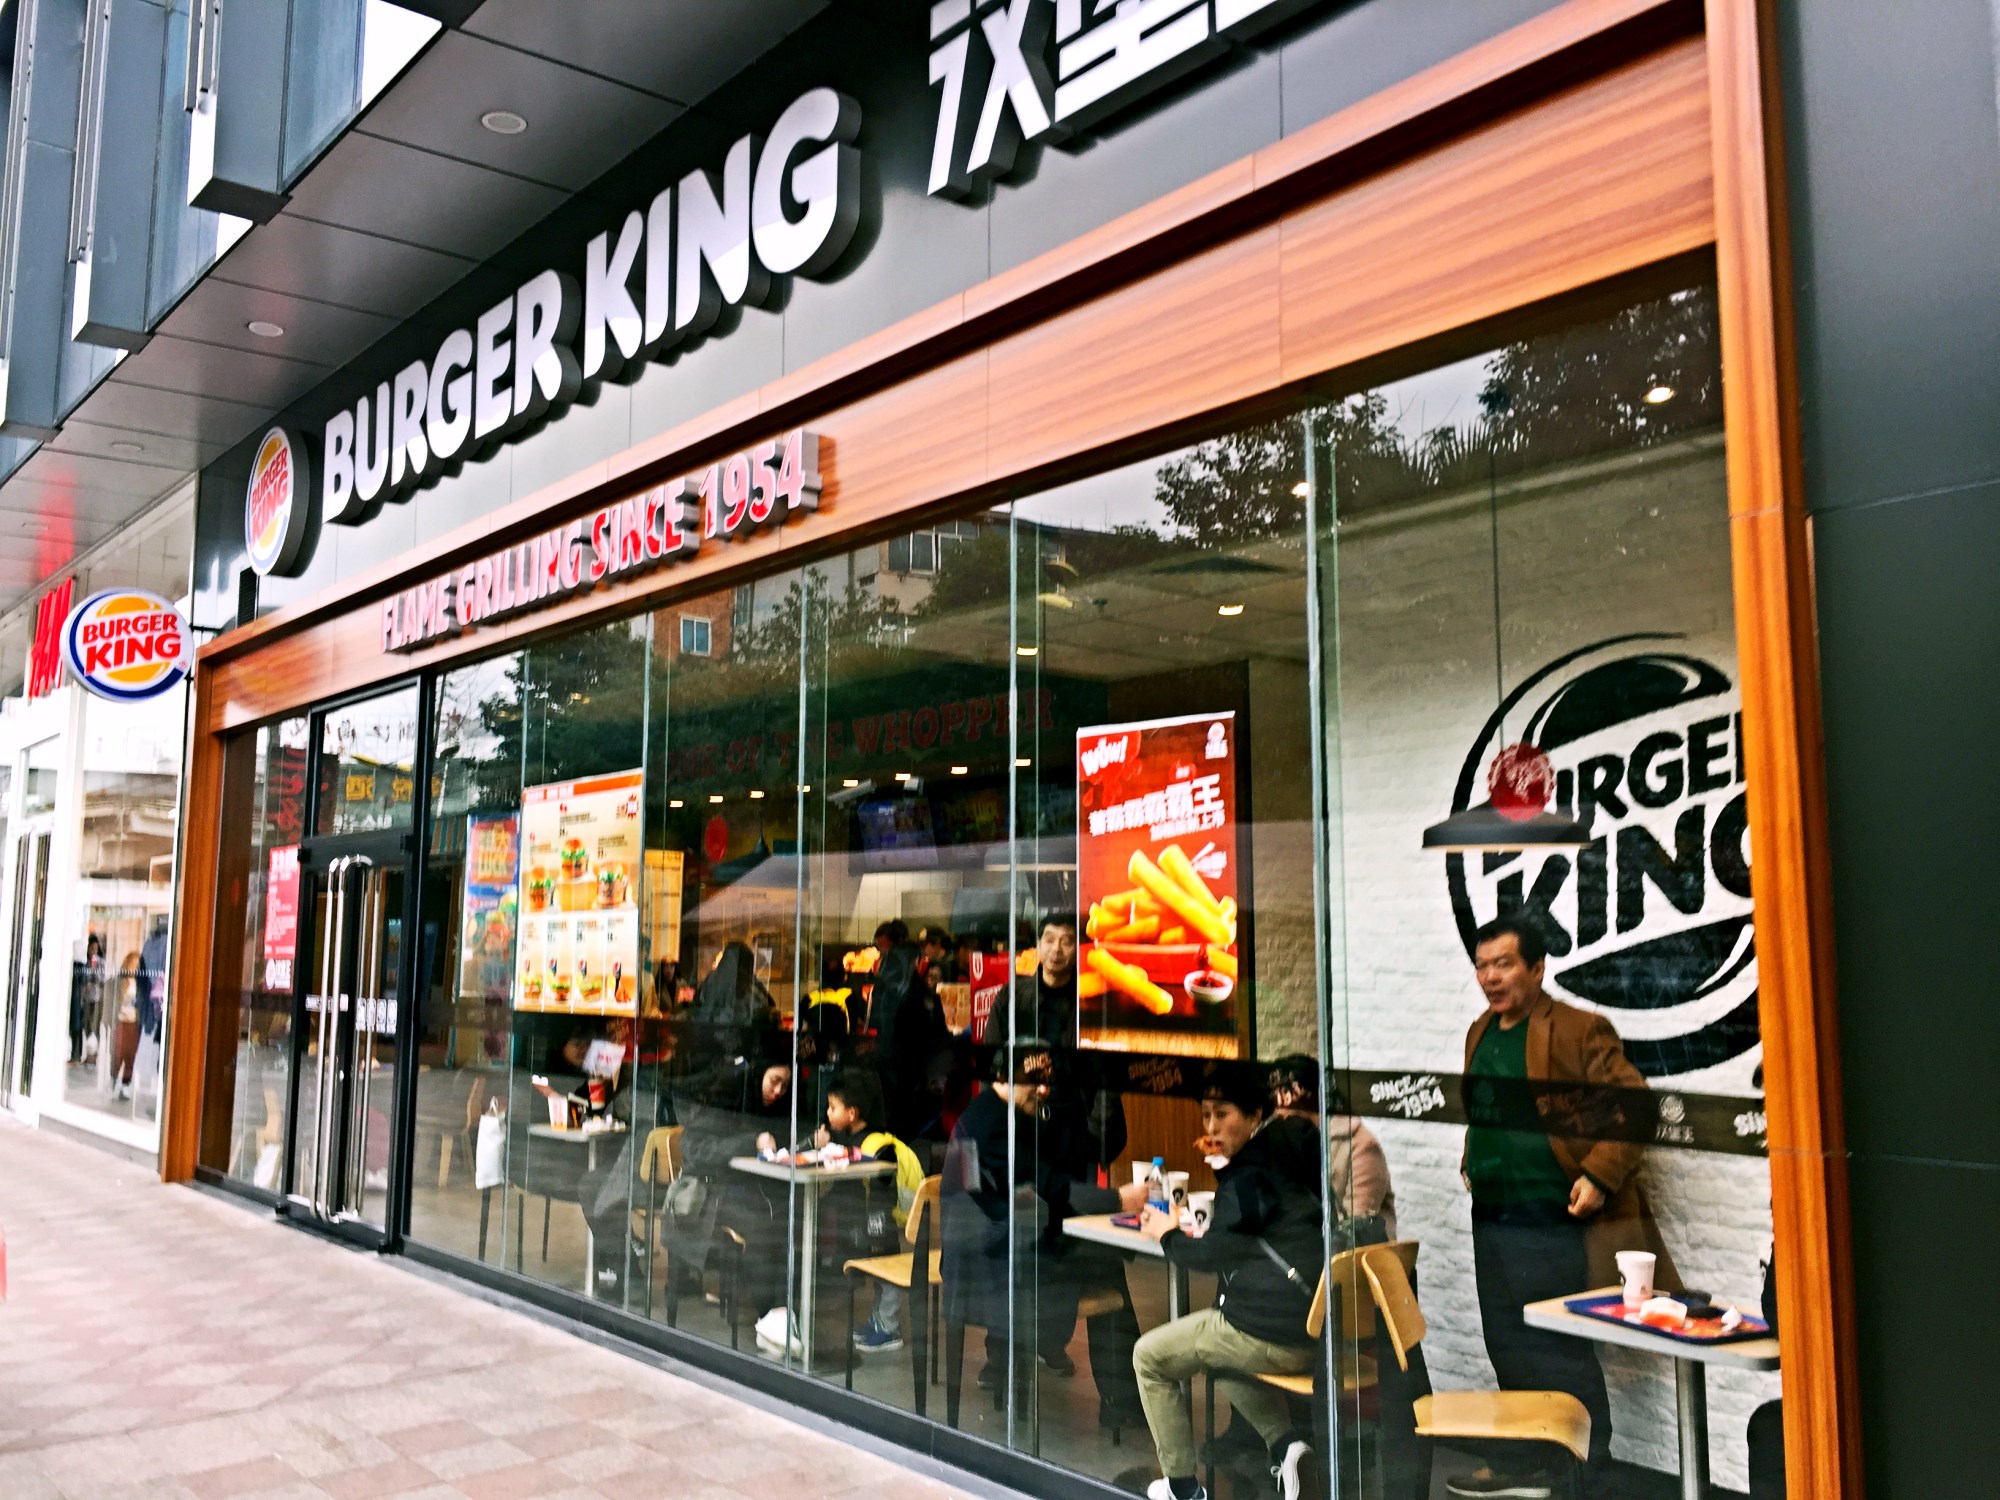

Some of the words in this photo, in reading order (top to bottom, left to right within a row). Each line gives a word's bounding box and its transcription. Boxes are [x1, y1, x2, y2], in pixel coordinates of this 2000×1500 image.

[927, 0, 1277, 196] 汉堡
[323, 268, 562, 524] BURGER
[584, 87, 840, 380] KING
[251, 447, 288, 514] BURGER
[251, 470, 288, 552] KING
[381, 573, 450, 652] FLAME
[456, 519, 582, 627] GRILLING
[590, 477, 687, 582] SINCE
[699, 428, 806, 539] 1954
[82, 613, 178, 646] BURGER
[84, 633, 182, 676] KING
[852, 687, 1053, 755] WHOPPER
[1554, 711, 1746, 832] RGE
[1370, 1075, 1412, 1103] SINCE
[1401, 1086, 1446, 1118] 1954
[1733, 1110, 1767, 1137] SIN
